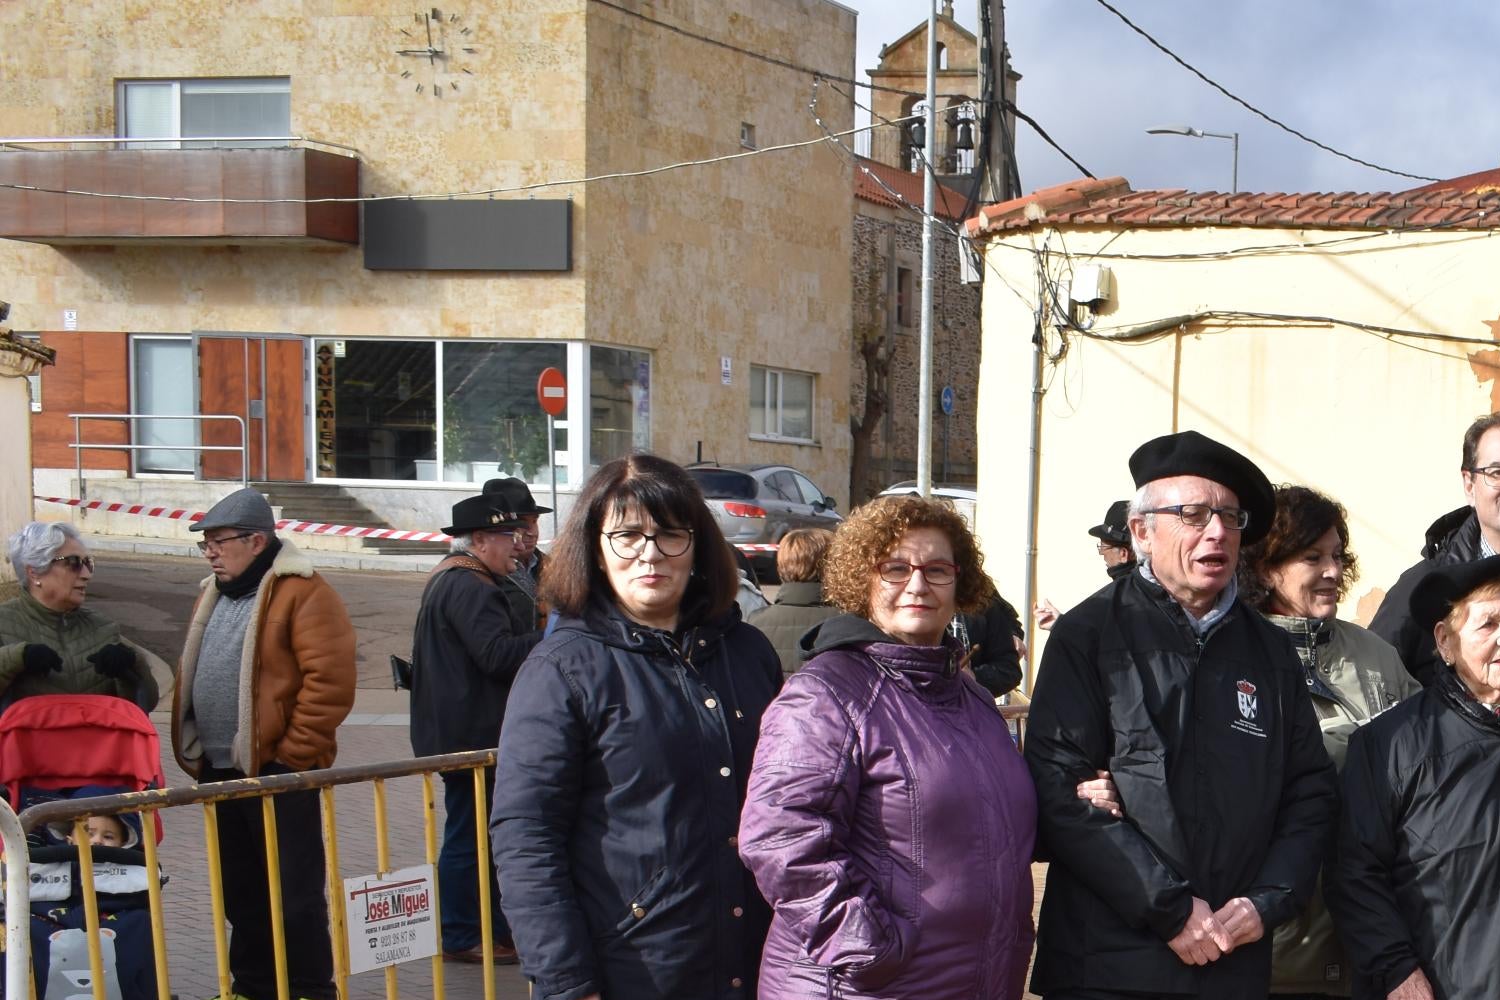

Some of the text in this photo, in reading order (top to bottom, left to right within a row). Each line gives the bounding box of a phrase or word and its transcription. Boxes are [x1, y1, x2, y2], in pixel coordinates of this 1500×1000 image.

[317, 345, 334, 473] AYUNTAMIENTO
[398, 884, 422, 893] REPUESTOS
[365, 882, 429, 920] José Miguel
[365, 926, 377, 934] VENTA
[382, 922, 400, 931] ALQUILER
[376, 946, 411, 964] SALAMANCA
